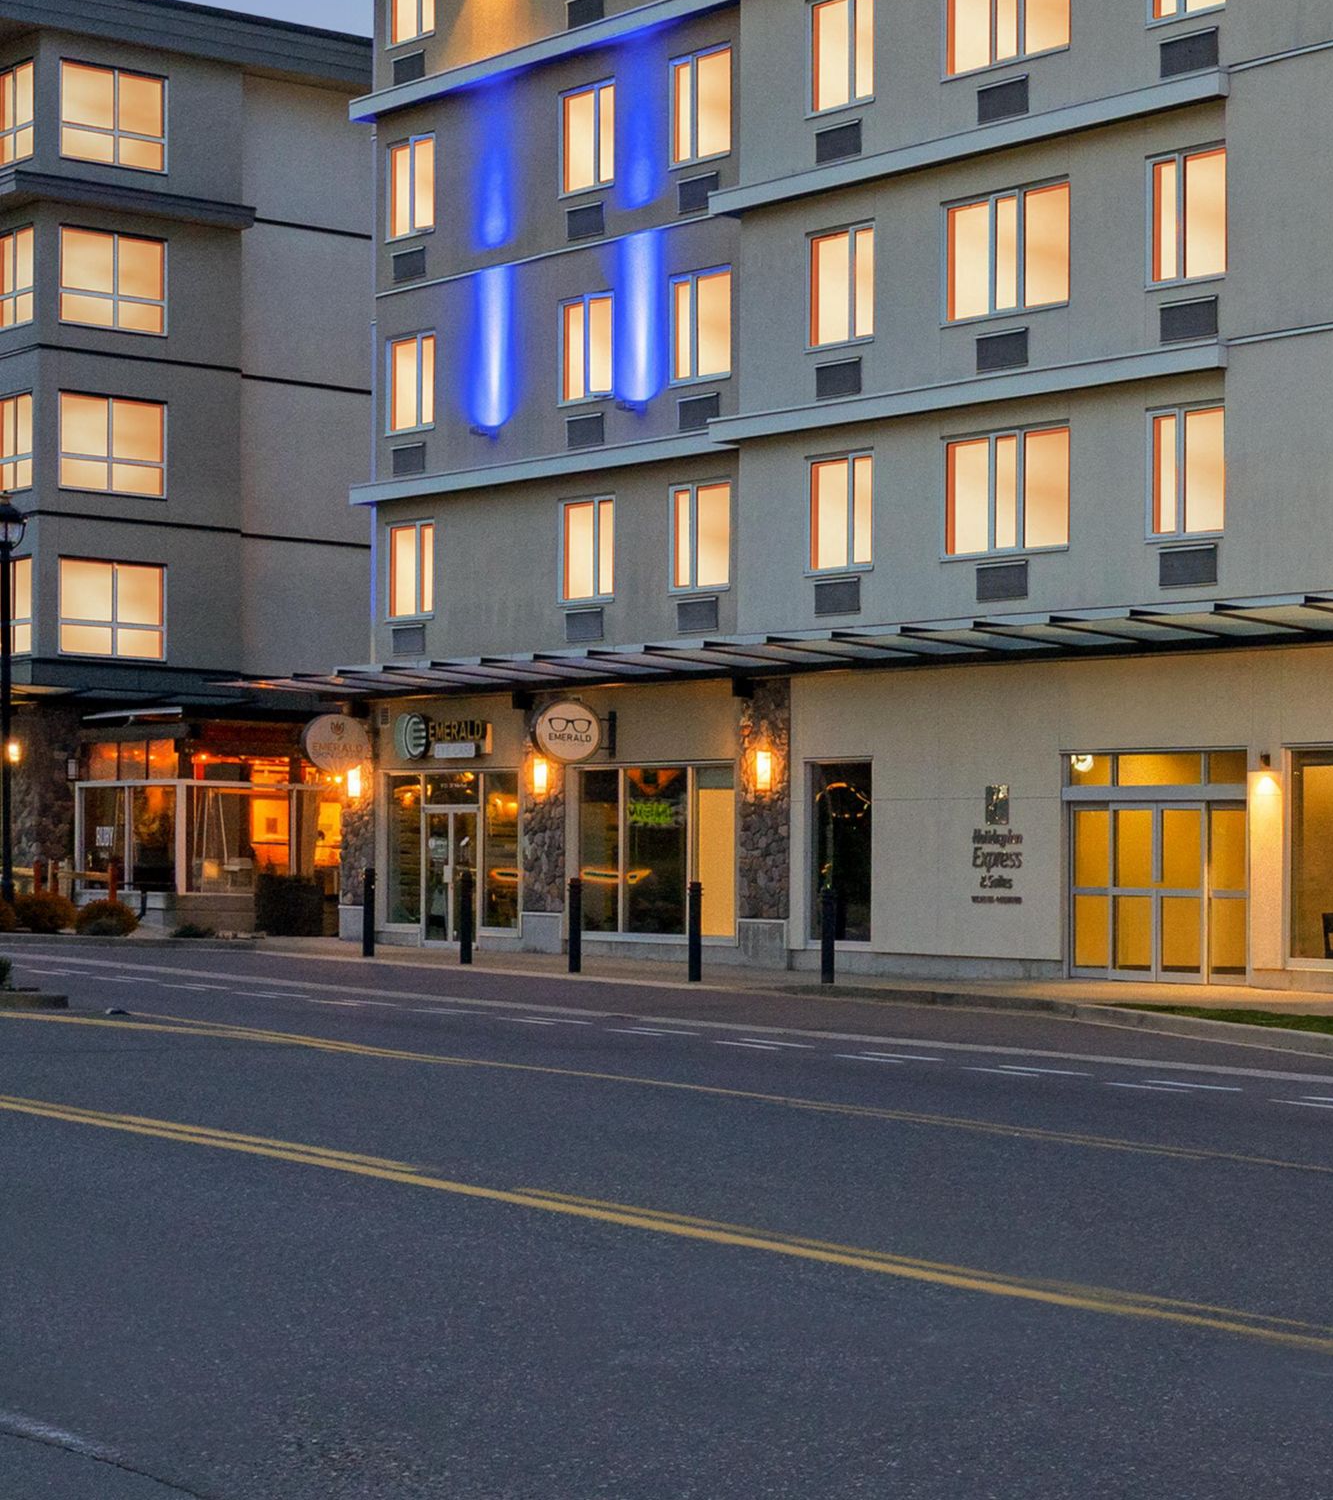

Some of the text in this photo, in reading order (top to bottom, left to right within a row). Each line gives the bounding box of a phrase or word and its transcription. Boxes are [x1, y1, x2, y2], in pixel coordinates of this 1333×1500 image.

[428, 720, 483, 741] EMERALD
[547, 731, 592, 743] EMERALD
[971, 846, 1023, 873] Express
